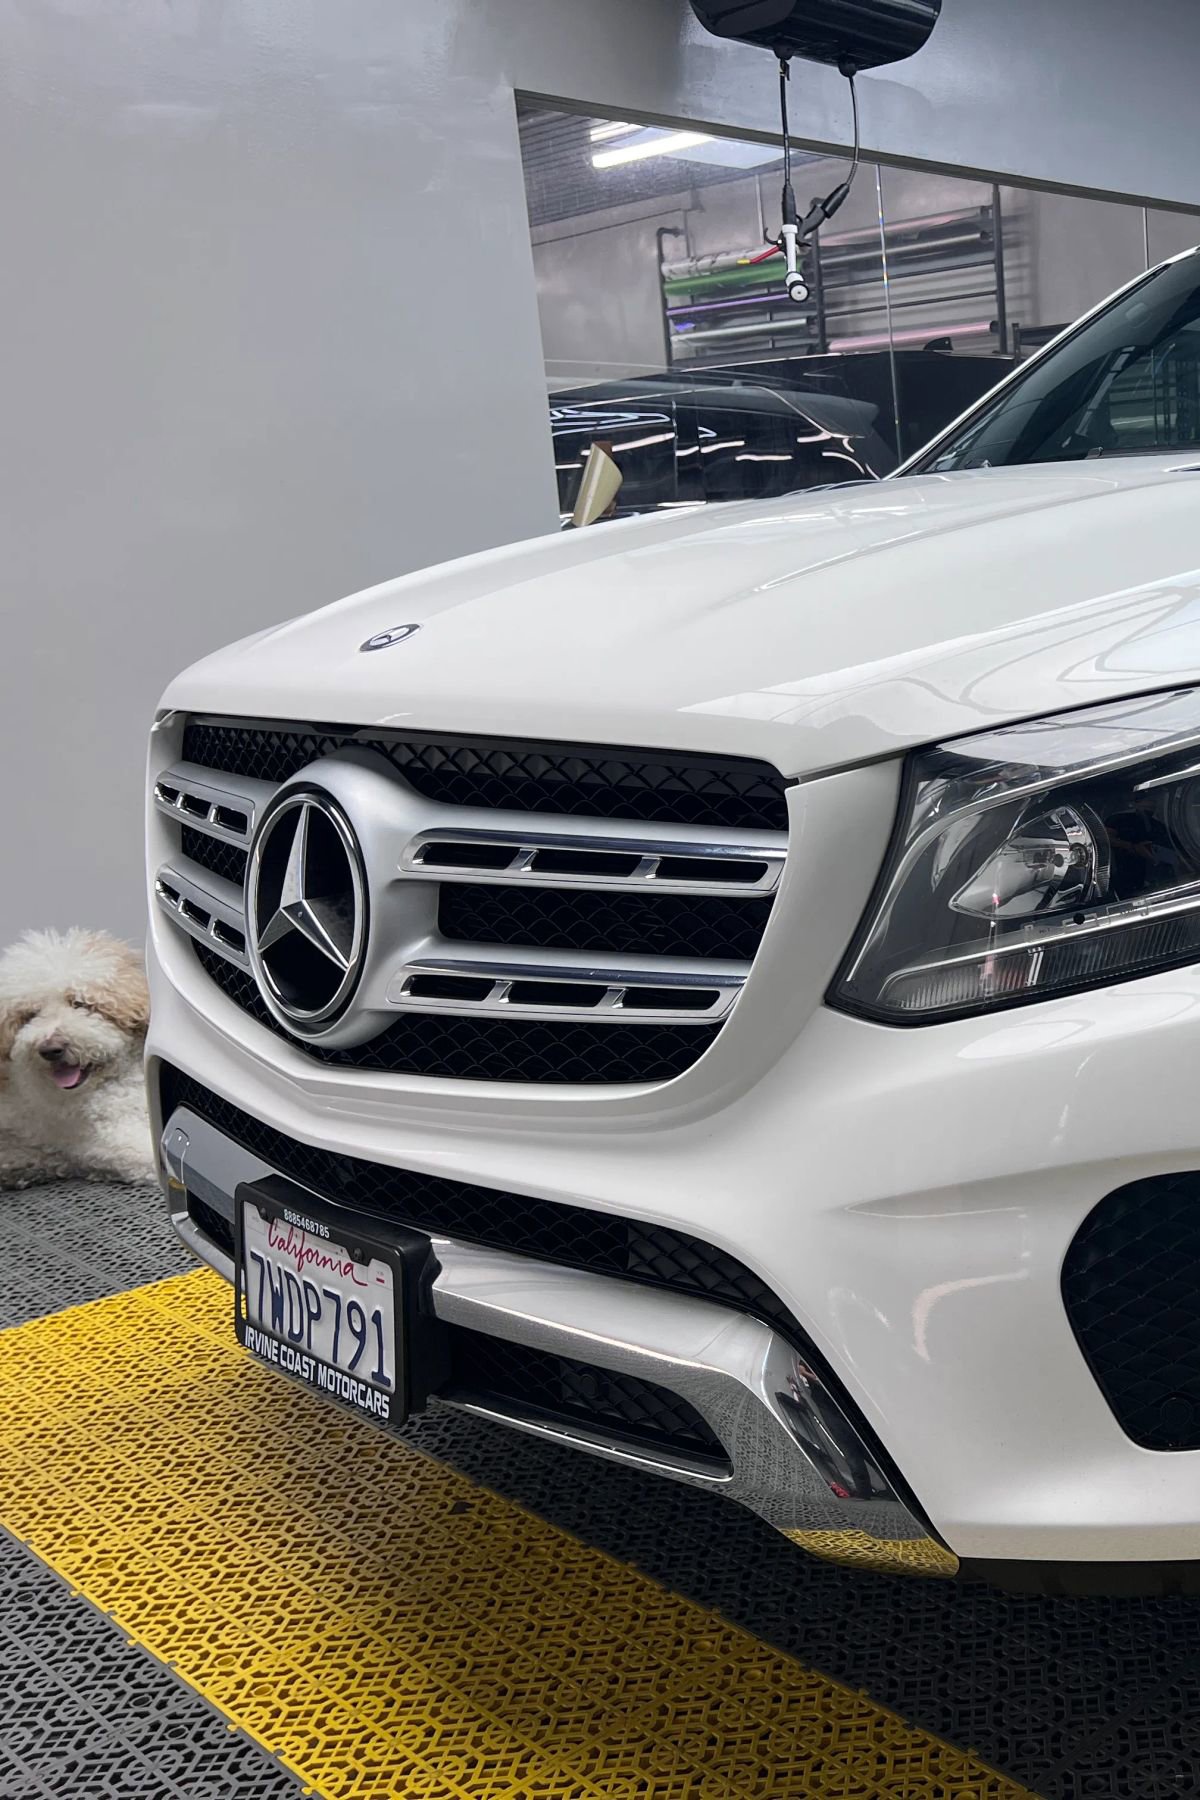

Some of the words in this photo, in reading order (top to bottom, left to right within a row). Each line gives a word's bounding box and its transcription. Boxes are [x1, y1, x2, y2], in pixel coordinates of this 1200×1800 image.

[267, 1219, 368, 1287] California
[283, 1208, 330, 1239] 8885468785
[249, 1250, 391, 1388] 7WDP791
[245, 1325, 279, 1364] IRVINE
[279, 1343, 317, 1383] COAST
[317, 1363, 390, 1419] MOTORCARS
